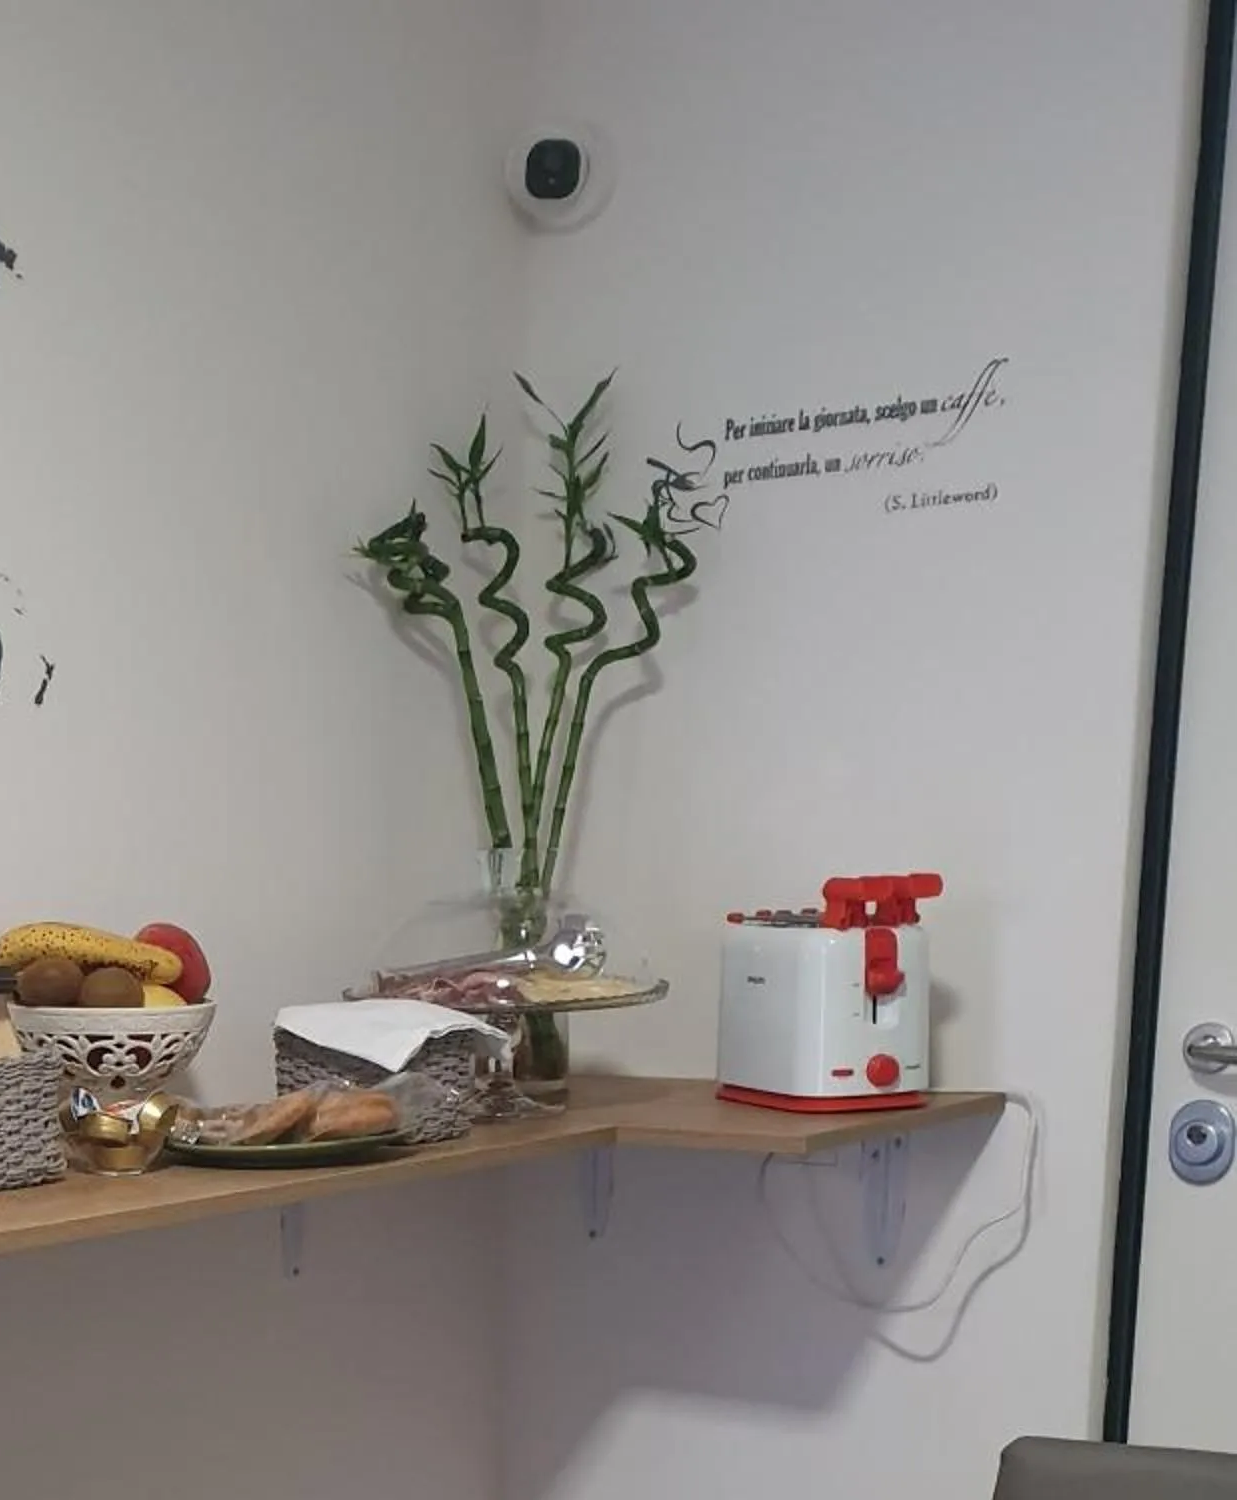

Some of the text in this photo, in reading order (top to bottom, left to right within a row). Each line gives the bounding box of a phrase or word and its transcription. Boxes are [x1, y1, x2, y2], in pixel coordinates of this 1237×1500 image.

[724, 418, 746, 440] Per
[749, 413, 795, 437] iniziare
[798, 408, 810, 431] la
[813, 406, 871, 432] giornata,
[874, 394, 917, 422] scelgo
[920, 398, 937, 414] un
[723, 468, 744, 489] per
[747, 452, 821, 480] continuarla,
[824, 457, 842, 473] un
[884, 482, 998, 513] (S. Littleword)
